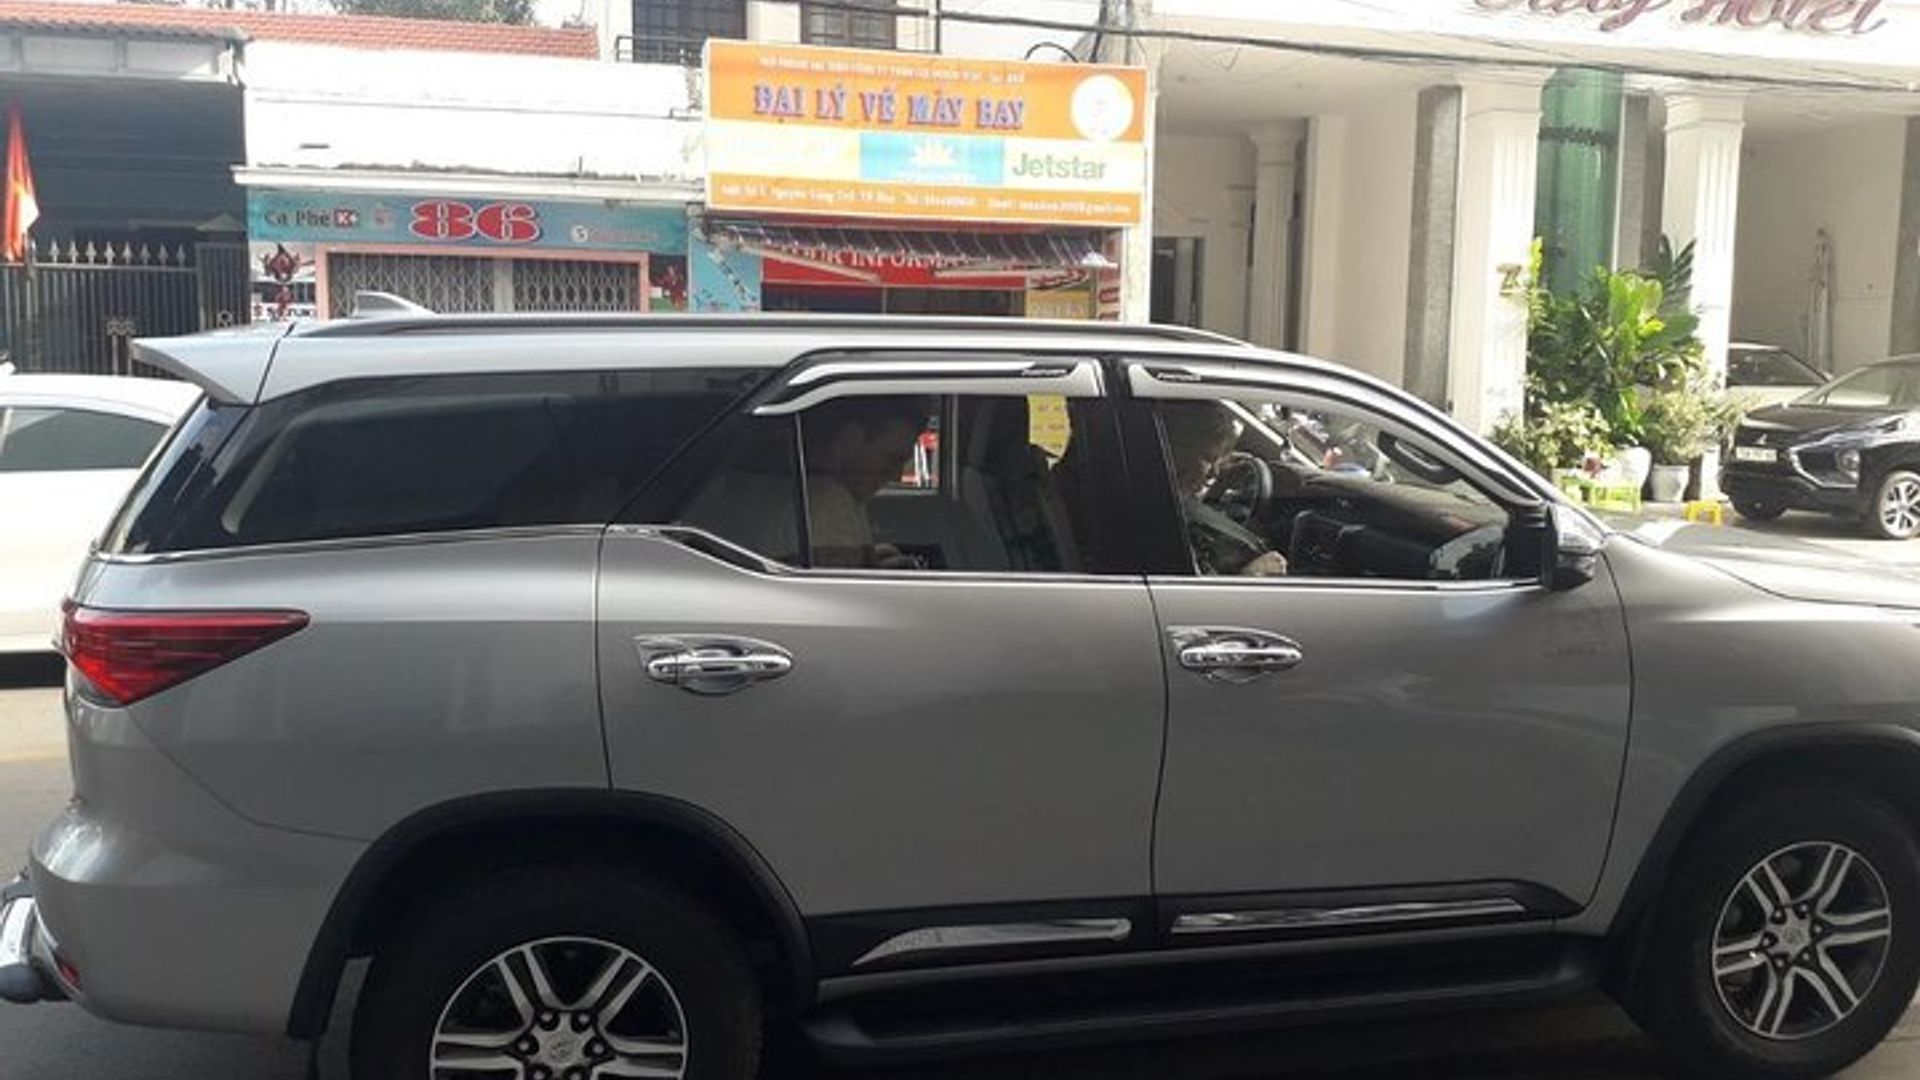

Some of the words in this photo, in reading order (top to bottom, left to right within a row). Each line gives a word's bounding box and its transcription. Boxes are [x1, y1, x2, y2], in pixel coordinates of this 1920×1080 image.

[975, 97, 1026, 131] BAY
[1011, 153, 1107, 179] Jetstar
[408, 198, 542, 242] 86
